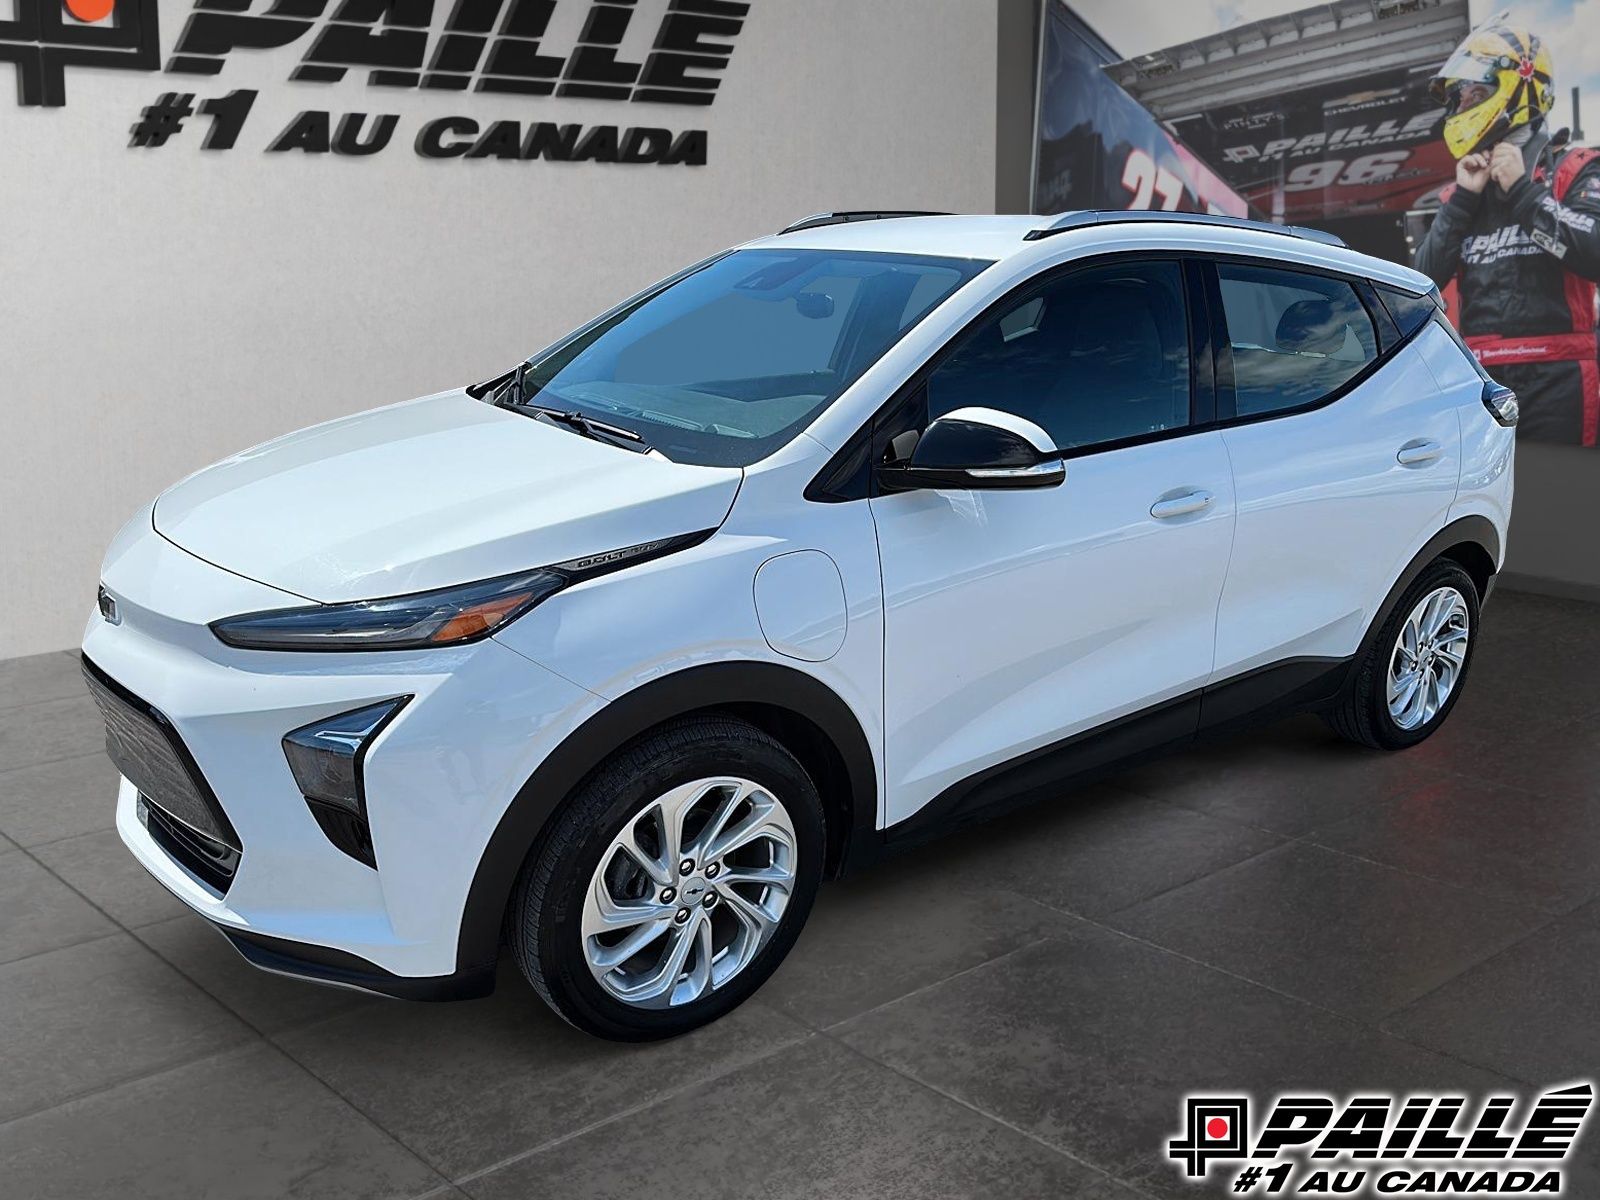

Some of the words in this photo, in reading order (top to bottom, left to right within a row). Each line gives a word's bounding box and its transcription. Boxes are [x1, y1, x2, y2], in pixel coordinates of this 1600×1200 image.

[127, 89, 259, 150] #1
[264, 110, 400, 156] AU
[414, 116, 708, 166] CANADA
[1323, 96, 1407, 117] CHEVROLET
[1289, 147, 1322, 158] AU
[1328, 129, 1432, 151] CANADA
[1121, 148, 1184, 212] 27
[1285, 150, 1411, 192] 96
